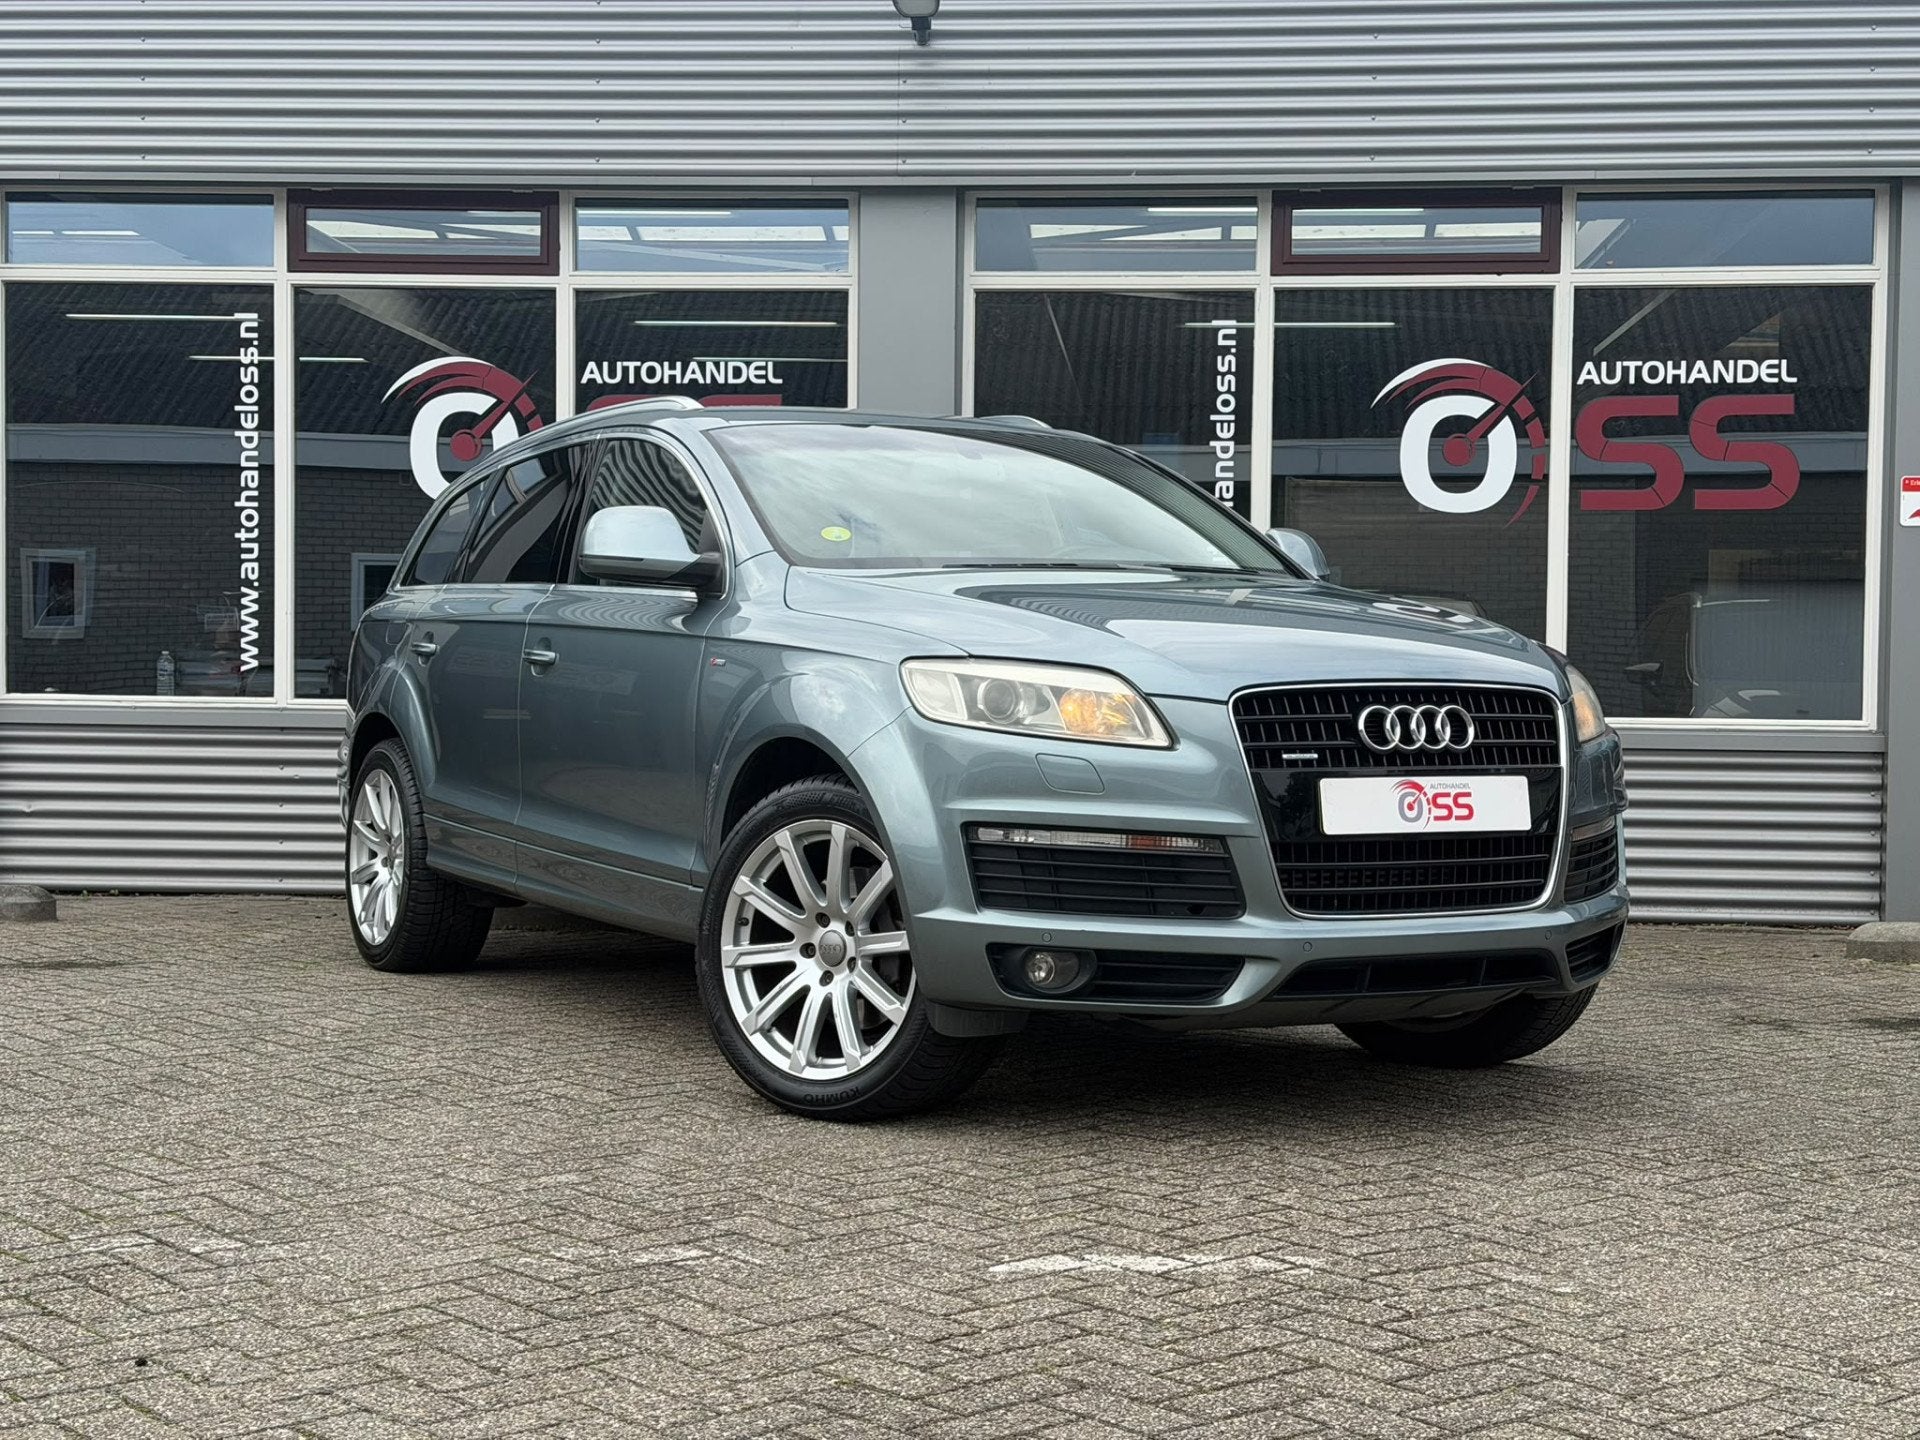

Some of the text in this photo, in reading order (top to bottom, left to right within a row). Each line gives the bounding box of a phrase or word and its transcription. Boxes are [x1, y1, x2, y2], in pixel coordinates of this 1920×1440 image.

[580, 361, 783, 385] AUTOHANDEL
[1577, 358, 1798, 386] AUTOHANDEL
[234, 313, 259, 672] www.autohandeloss.nl
